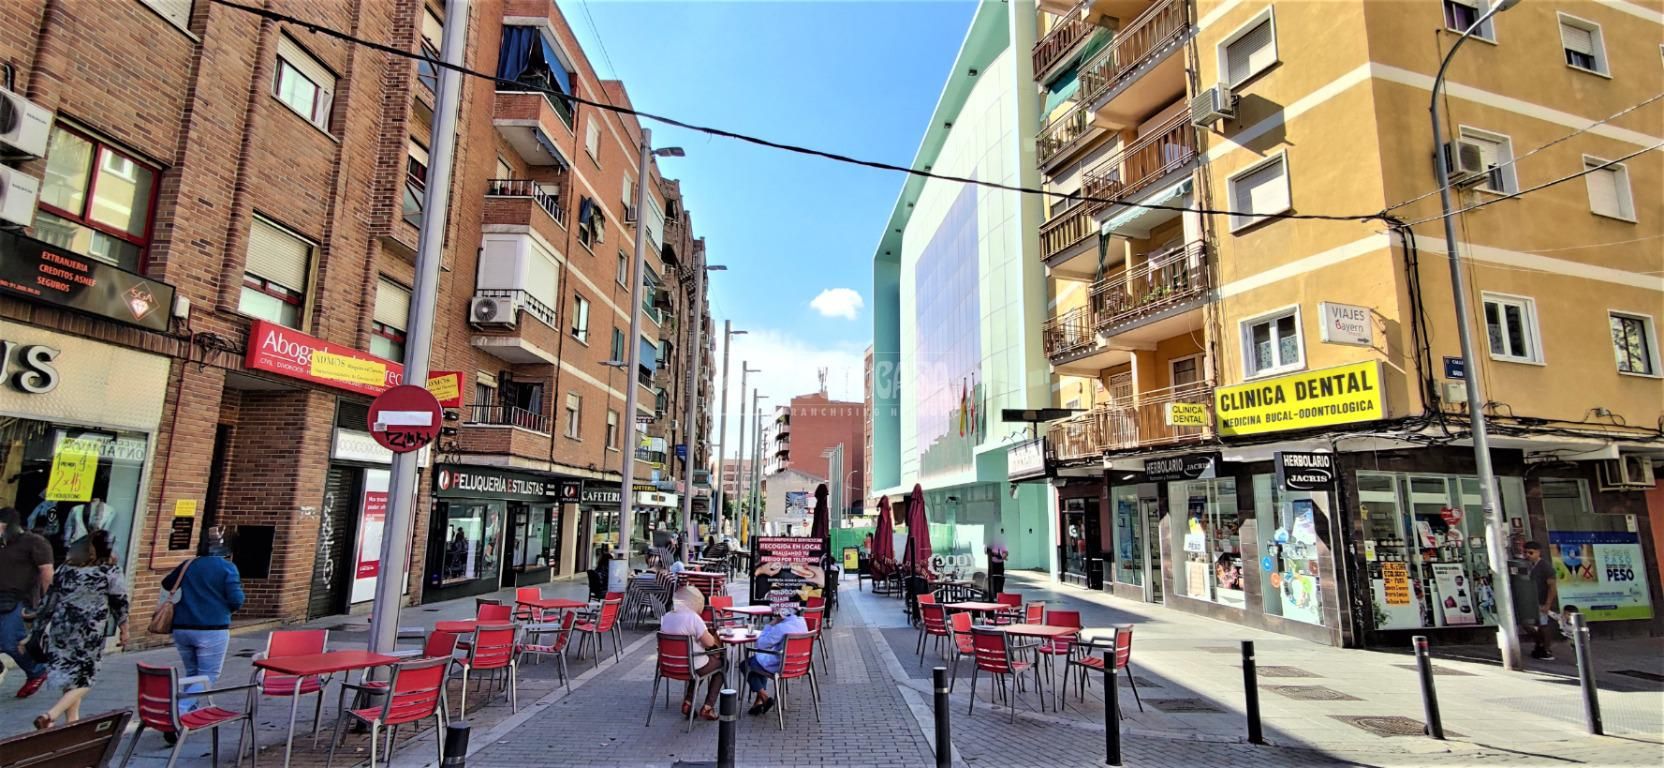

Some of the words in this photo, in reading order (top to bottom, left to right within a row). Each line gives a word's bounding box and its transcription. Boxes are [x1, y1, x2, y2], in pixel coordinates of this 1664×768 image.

[40, 264, 73, 281] CREDITOS
[37, 276, 70, 292] SEGUROS
[1332, 306, 1365, 321] VIAJES
[1220, 384, 1286, 412] CLINICA
[1295, 370, 1373, 401] DENTAL
[1172, 405, 1203, 414] CLINICA
[1222, 414, 1261, 428] MEDICINA
[1265, 399, 1374, 423] BUCAL-ODONTOLOGICA
[1173, 415, 1203, 424] DENTAL
[1146, 458, 1183, 475] HERBOLARIO
[1283, 455, 1330, 467] HERBOLARIO
[453, 472, 506, 492] PELUQUERÍA
[507, 478, 544, 495] ESTILISTAS
[1606, 568, 1634, 582] PESO
